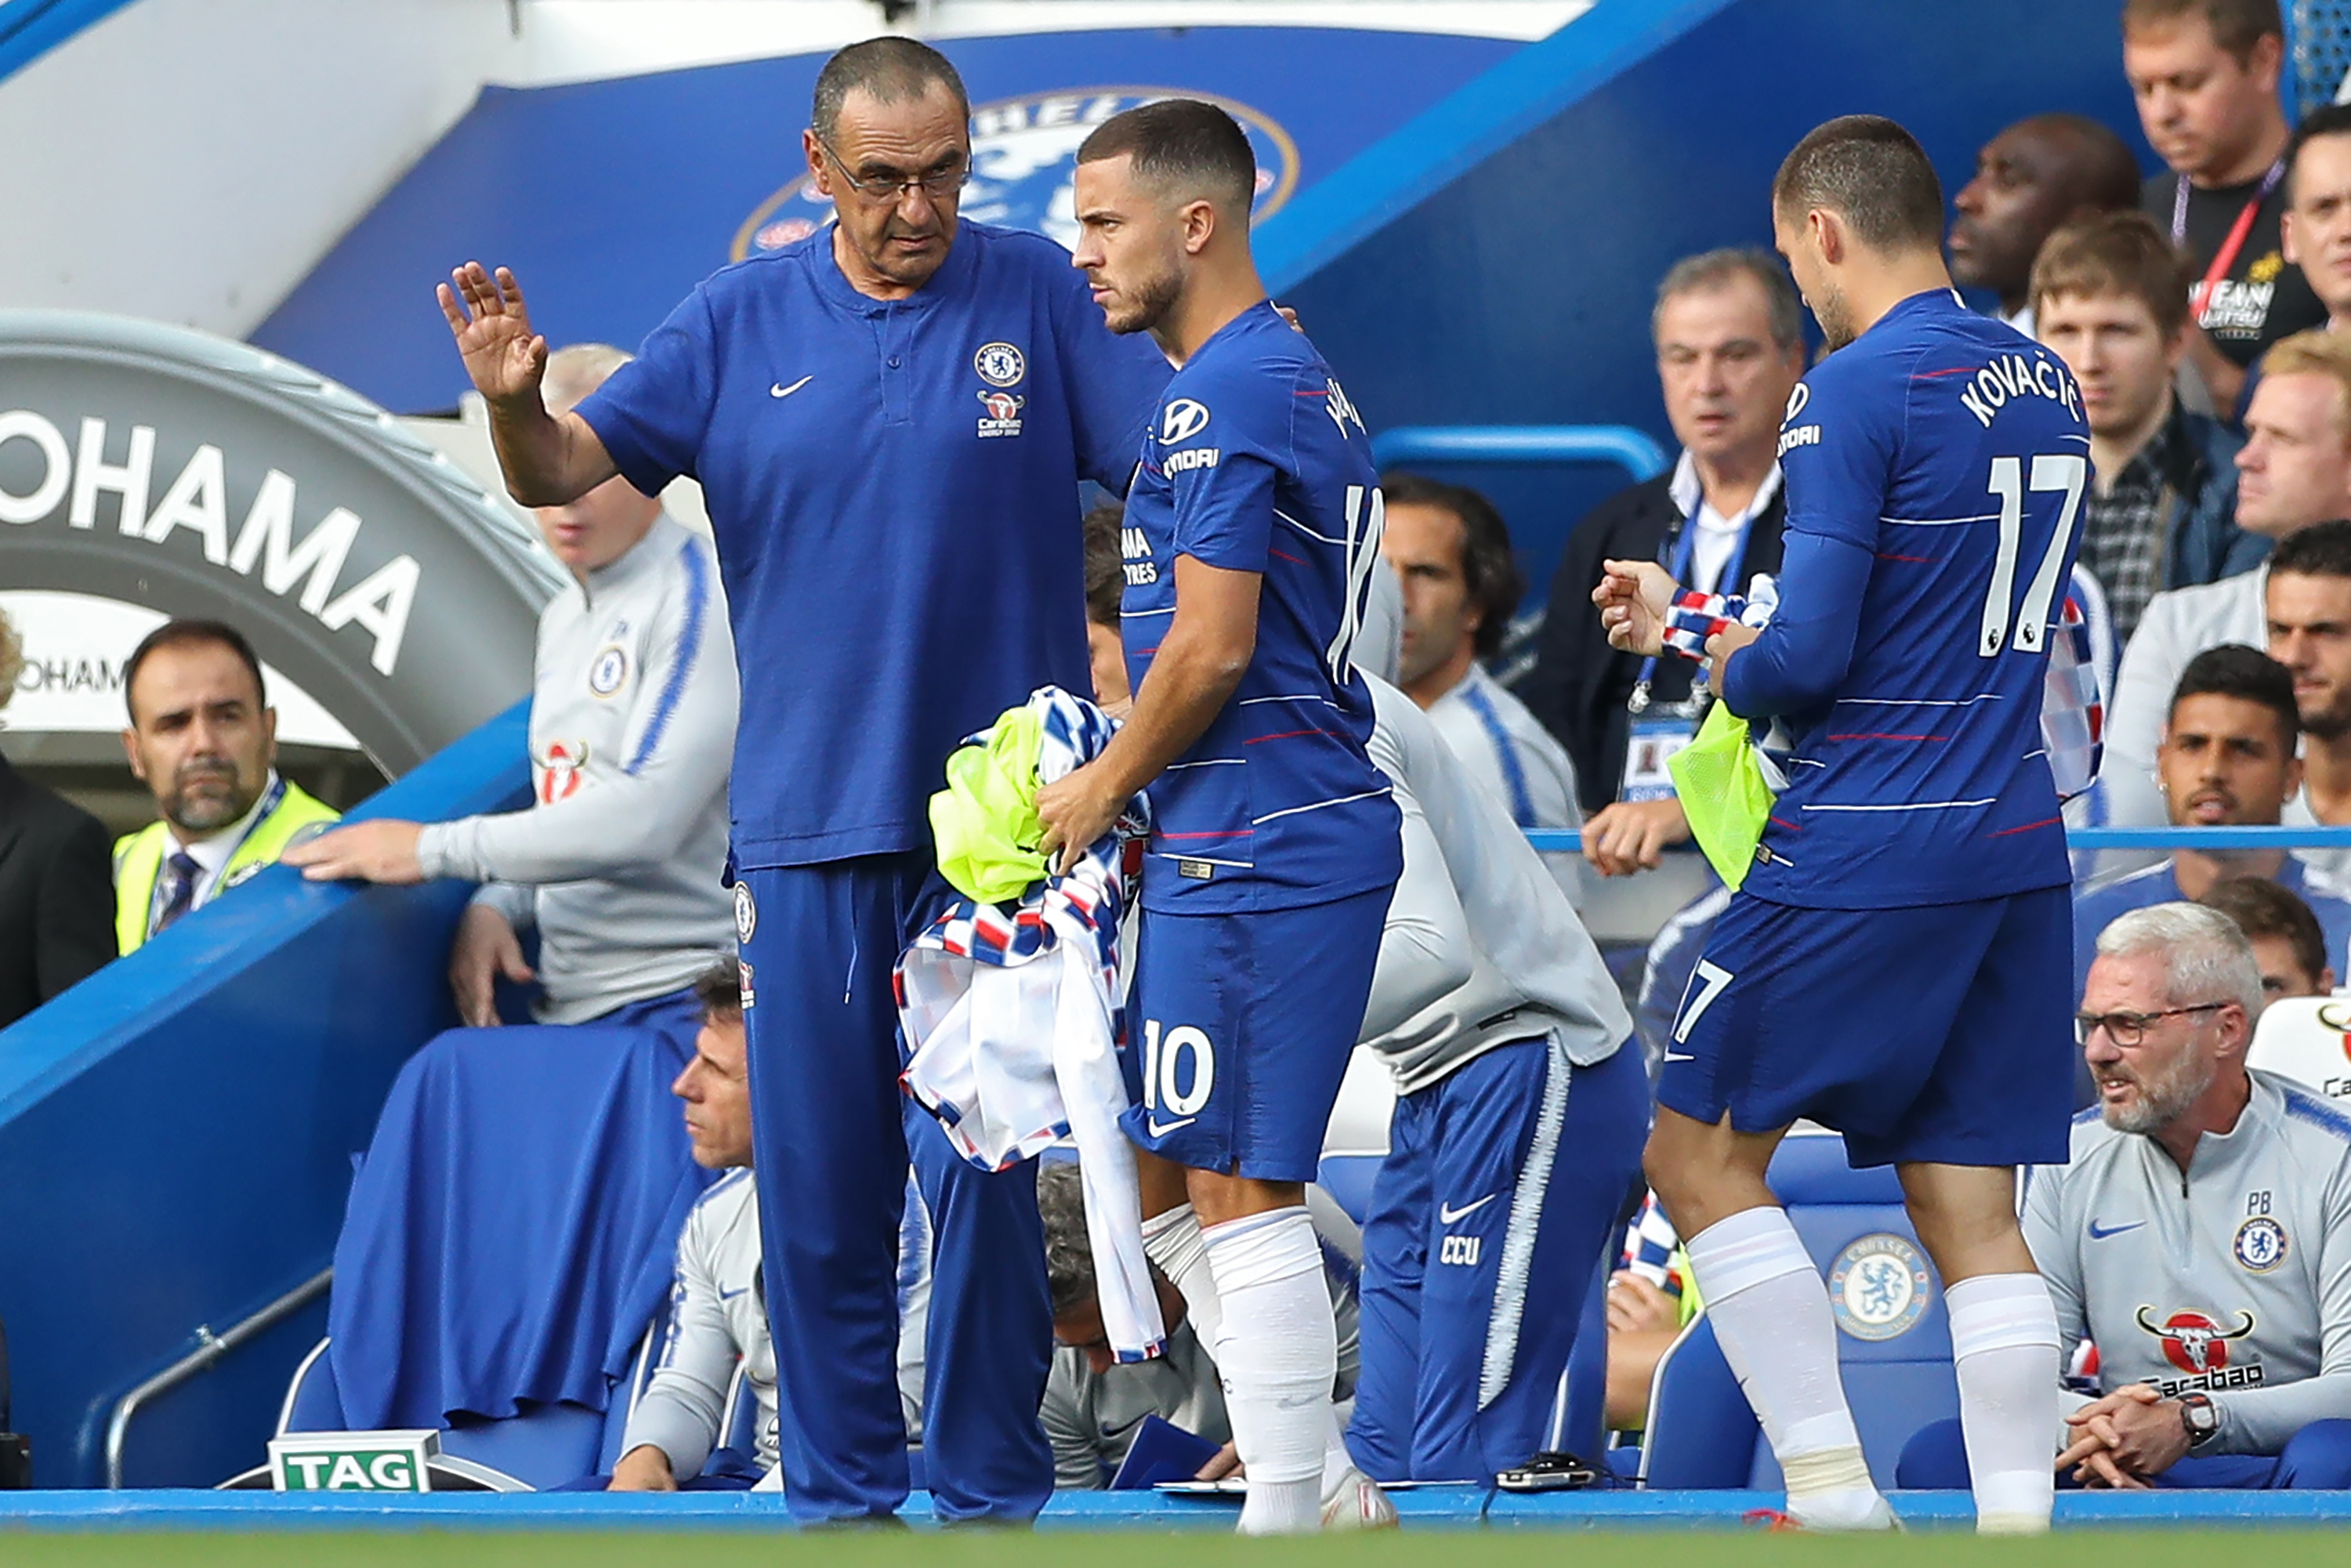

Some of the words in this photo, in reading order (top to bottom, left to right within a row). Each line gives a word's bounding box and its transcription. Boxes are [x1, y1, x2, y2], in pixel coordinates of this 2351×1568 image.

[0, 410, 422, 676] OHAMA
[1979, 455, 2087, 657] 17
[1144, 1019, 1214, 1116] 10
[2247, 1190, 2272, 1216] PB
[1440, 1236, 1480, 1266] CCU
[2139, 1365, 2265, 1398] arabao
[287, 1454, 411, 1489] TAG
